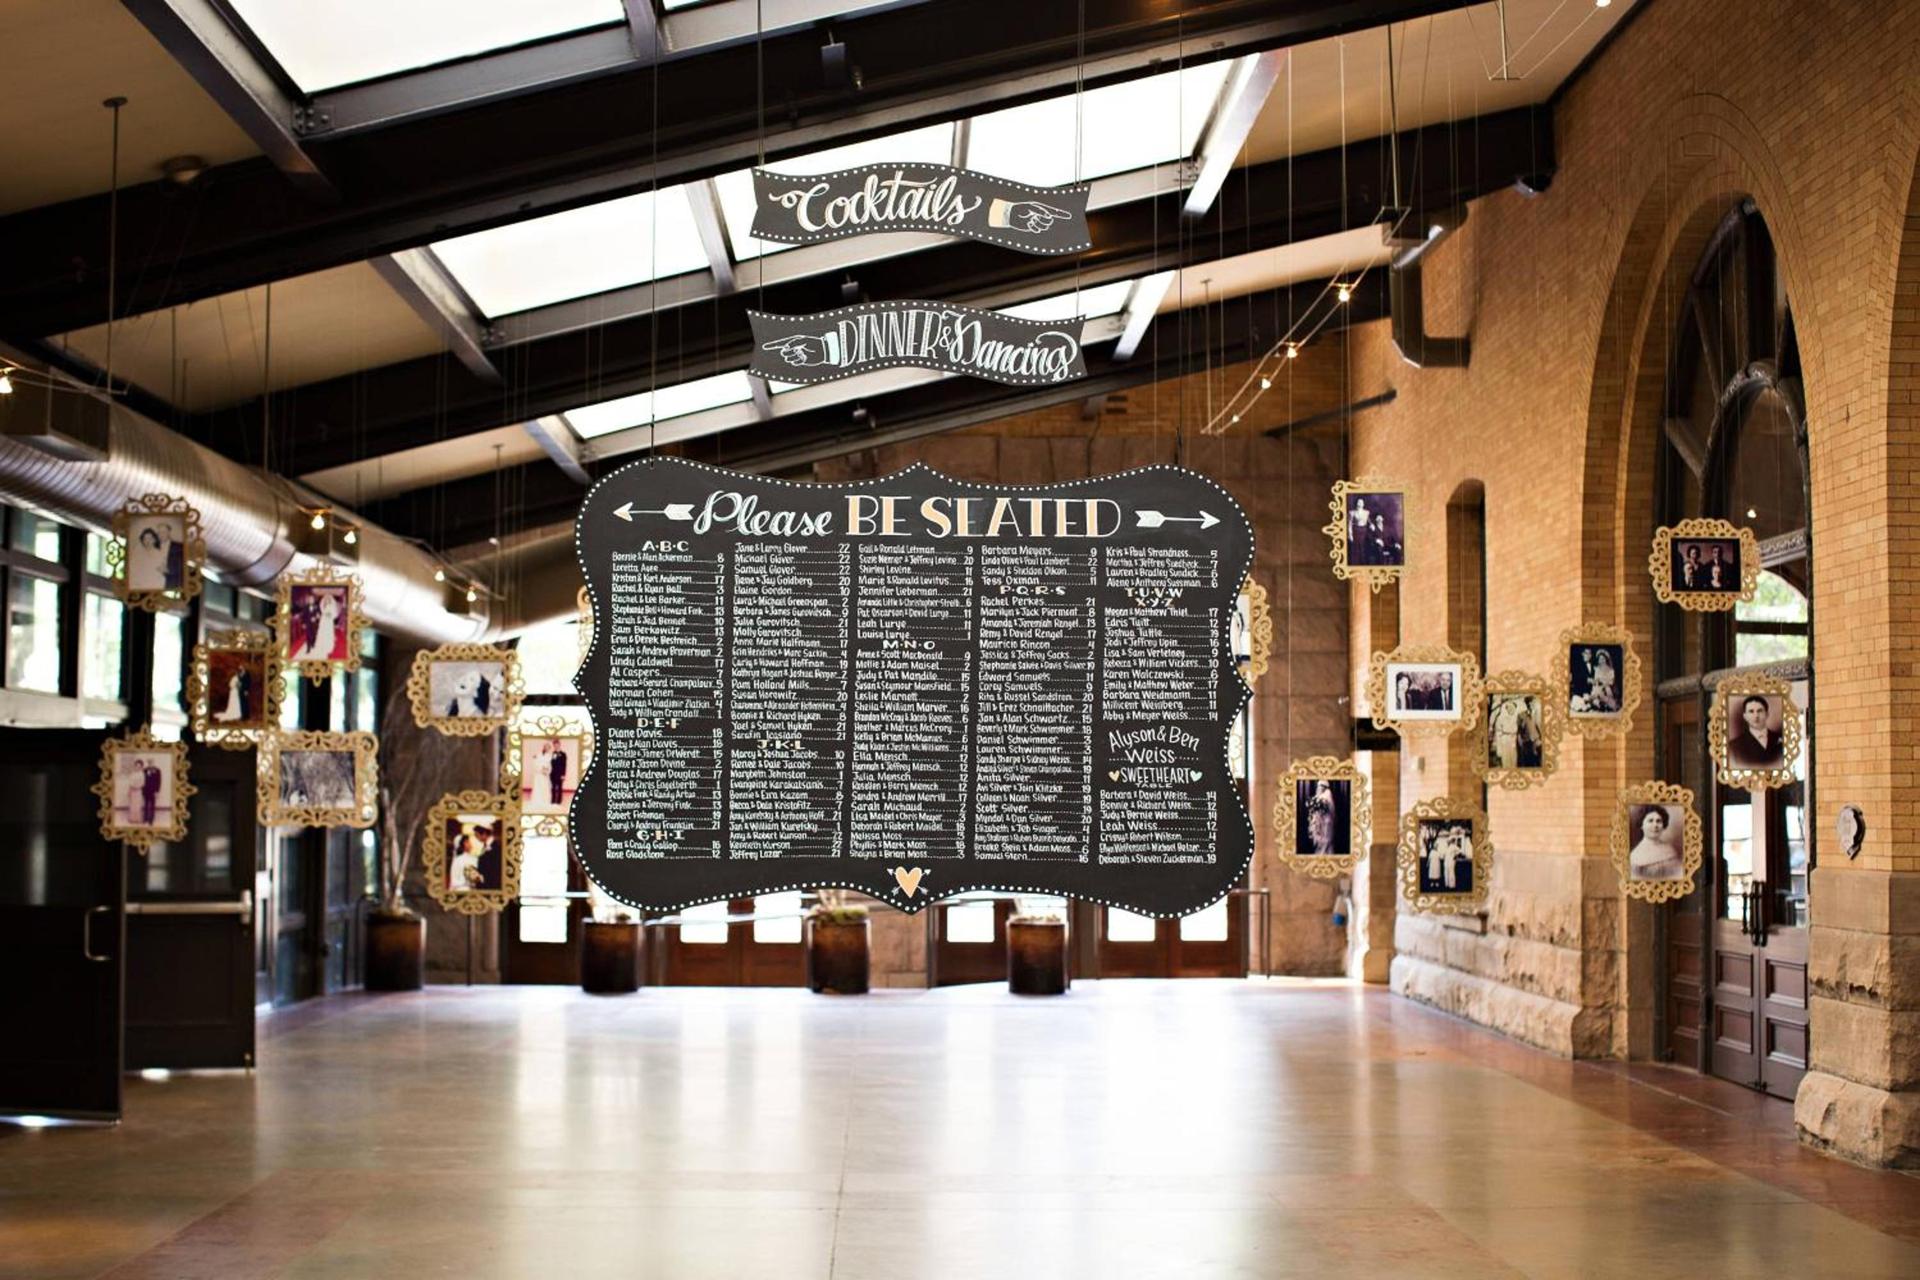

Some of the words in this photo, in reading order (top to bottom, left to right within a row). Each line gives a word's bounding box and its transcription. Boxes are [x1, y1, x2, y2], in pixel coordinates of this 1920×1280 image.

[769, 169, 982, 232] Cocktails
[838, 310, 943, 367] DINNER
[693, 491, 834, 537] Please
[844, 494, 911, 536] BE
[919, 494, 1122, 538] SEATED
[839, 554, 850, 564] 22
[734, 565, 767, 574] Samuel
[839, 566, 850, 575] 22
[612, 626, 631, 635] Sam
[1128, 648, 1145, 657] Sam
[1211, 648, 1218, 657] 9
[608, 728, 635, 738] Diane
[637, 729, 663, 738] Davis
[1109, 727, 1156, 752] Alyson
[1169, 726, 1200, 752] Ben
[1125, 747, 1175, 764] Weiss
[1120, 767, 1191, 784] SWEETHEART
[1100, 822, 1124, 832] Leah
[1127, 822, 1158, 831] Weiss
